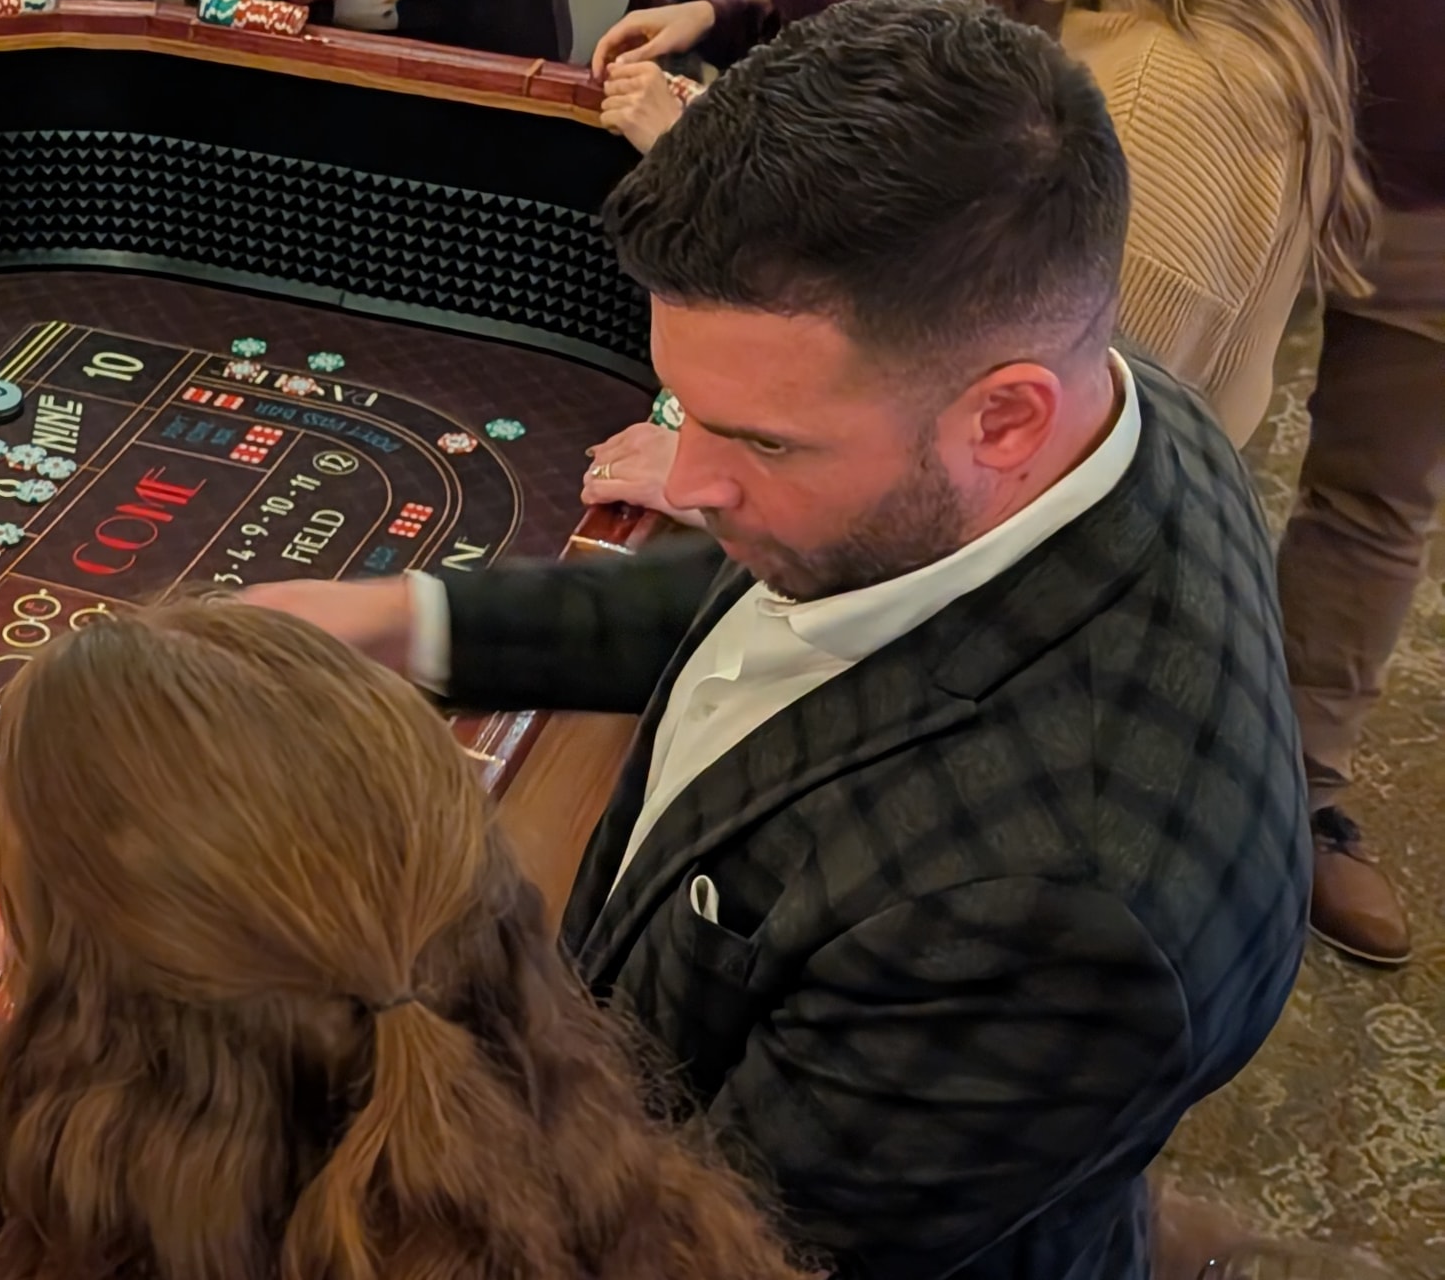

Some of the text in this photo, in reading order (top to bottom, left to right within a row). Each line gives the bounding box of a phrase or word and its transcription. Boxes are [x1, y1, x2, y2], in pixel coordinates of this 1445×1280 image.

[82, 351, 145, 383] 10
[32, 393, 84, 454] NINE
[72, 466, 208, 575] COME
[213, 453, 354, 585] 3 4 9 10 11 12
[281, 509, 345, 564] FIELD
